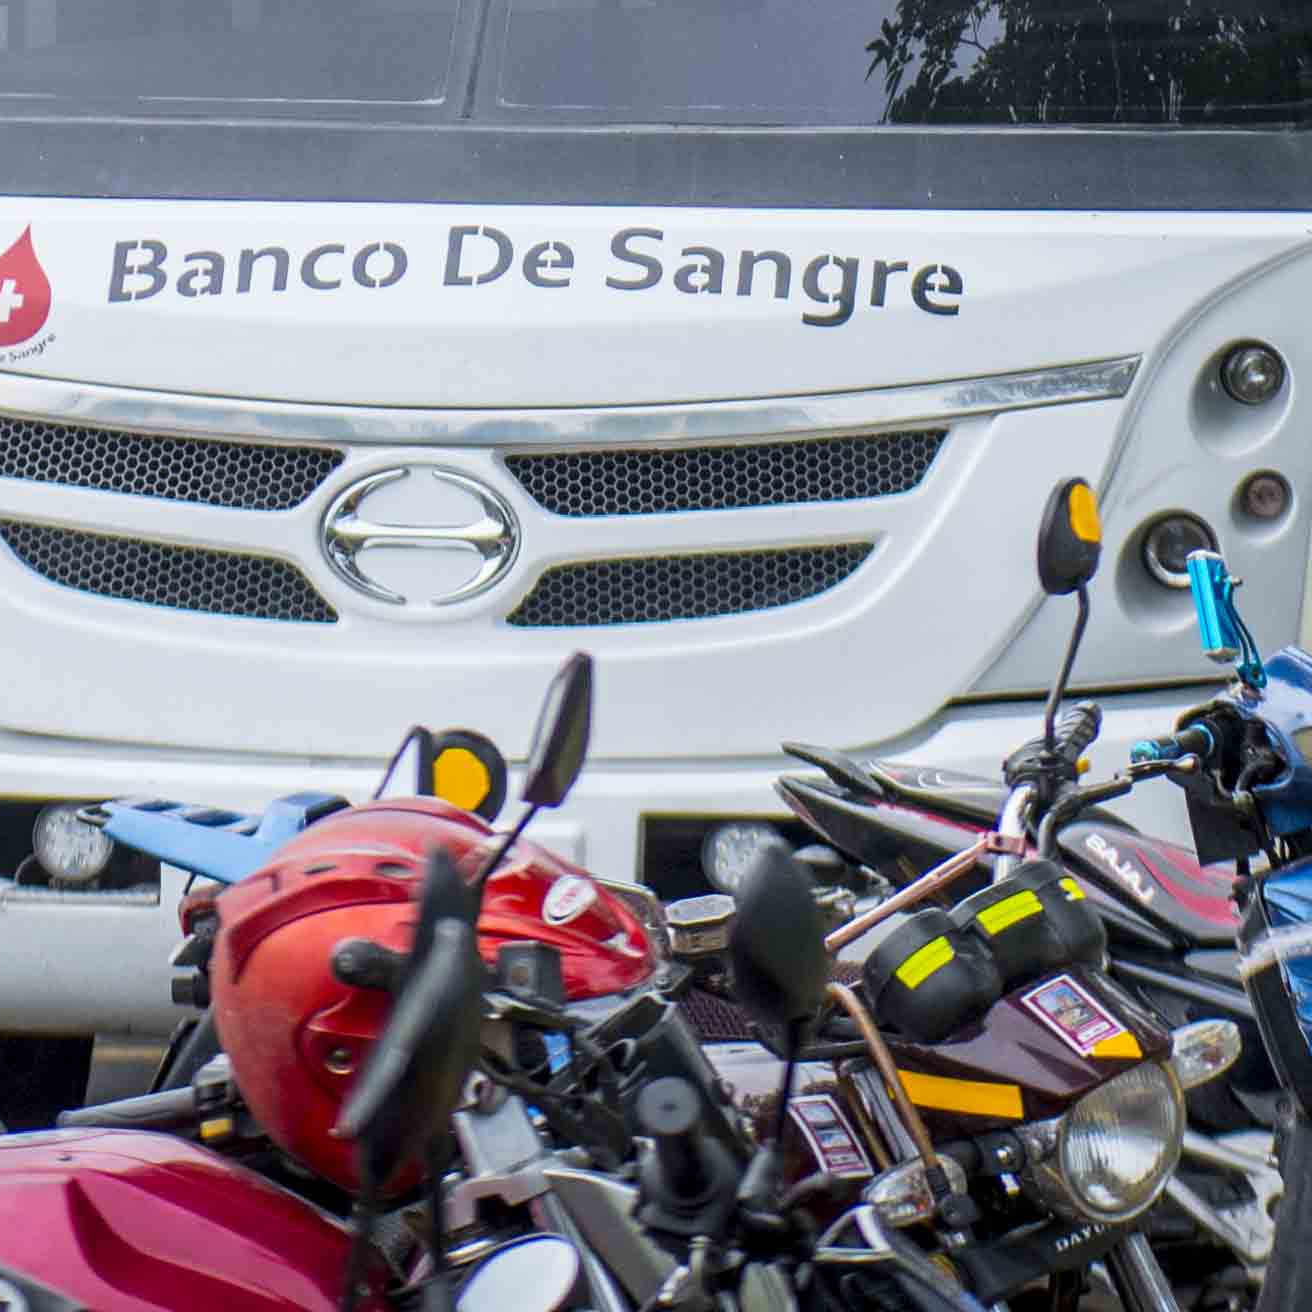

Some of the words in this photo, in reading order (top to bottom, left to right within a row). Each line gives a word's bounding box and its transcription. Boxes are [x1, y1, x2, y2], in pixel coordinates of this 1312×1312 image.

[108, 240, 408, 303] Banco
[443, 226, 575, 288] De
[605, 228, 964, 328] Sangre
[1085, 833, 1155, 901] BAJAJ
